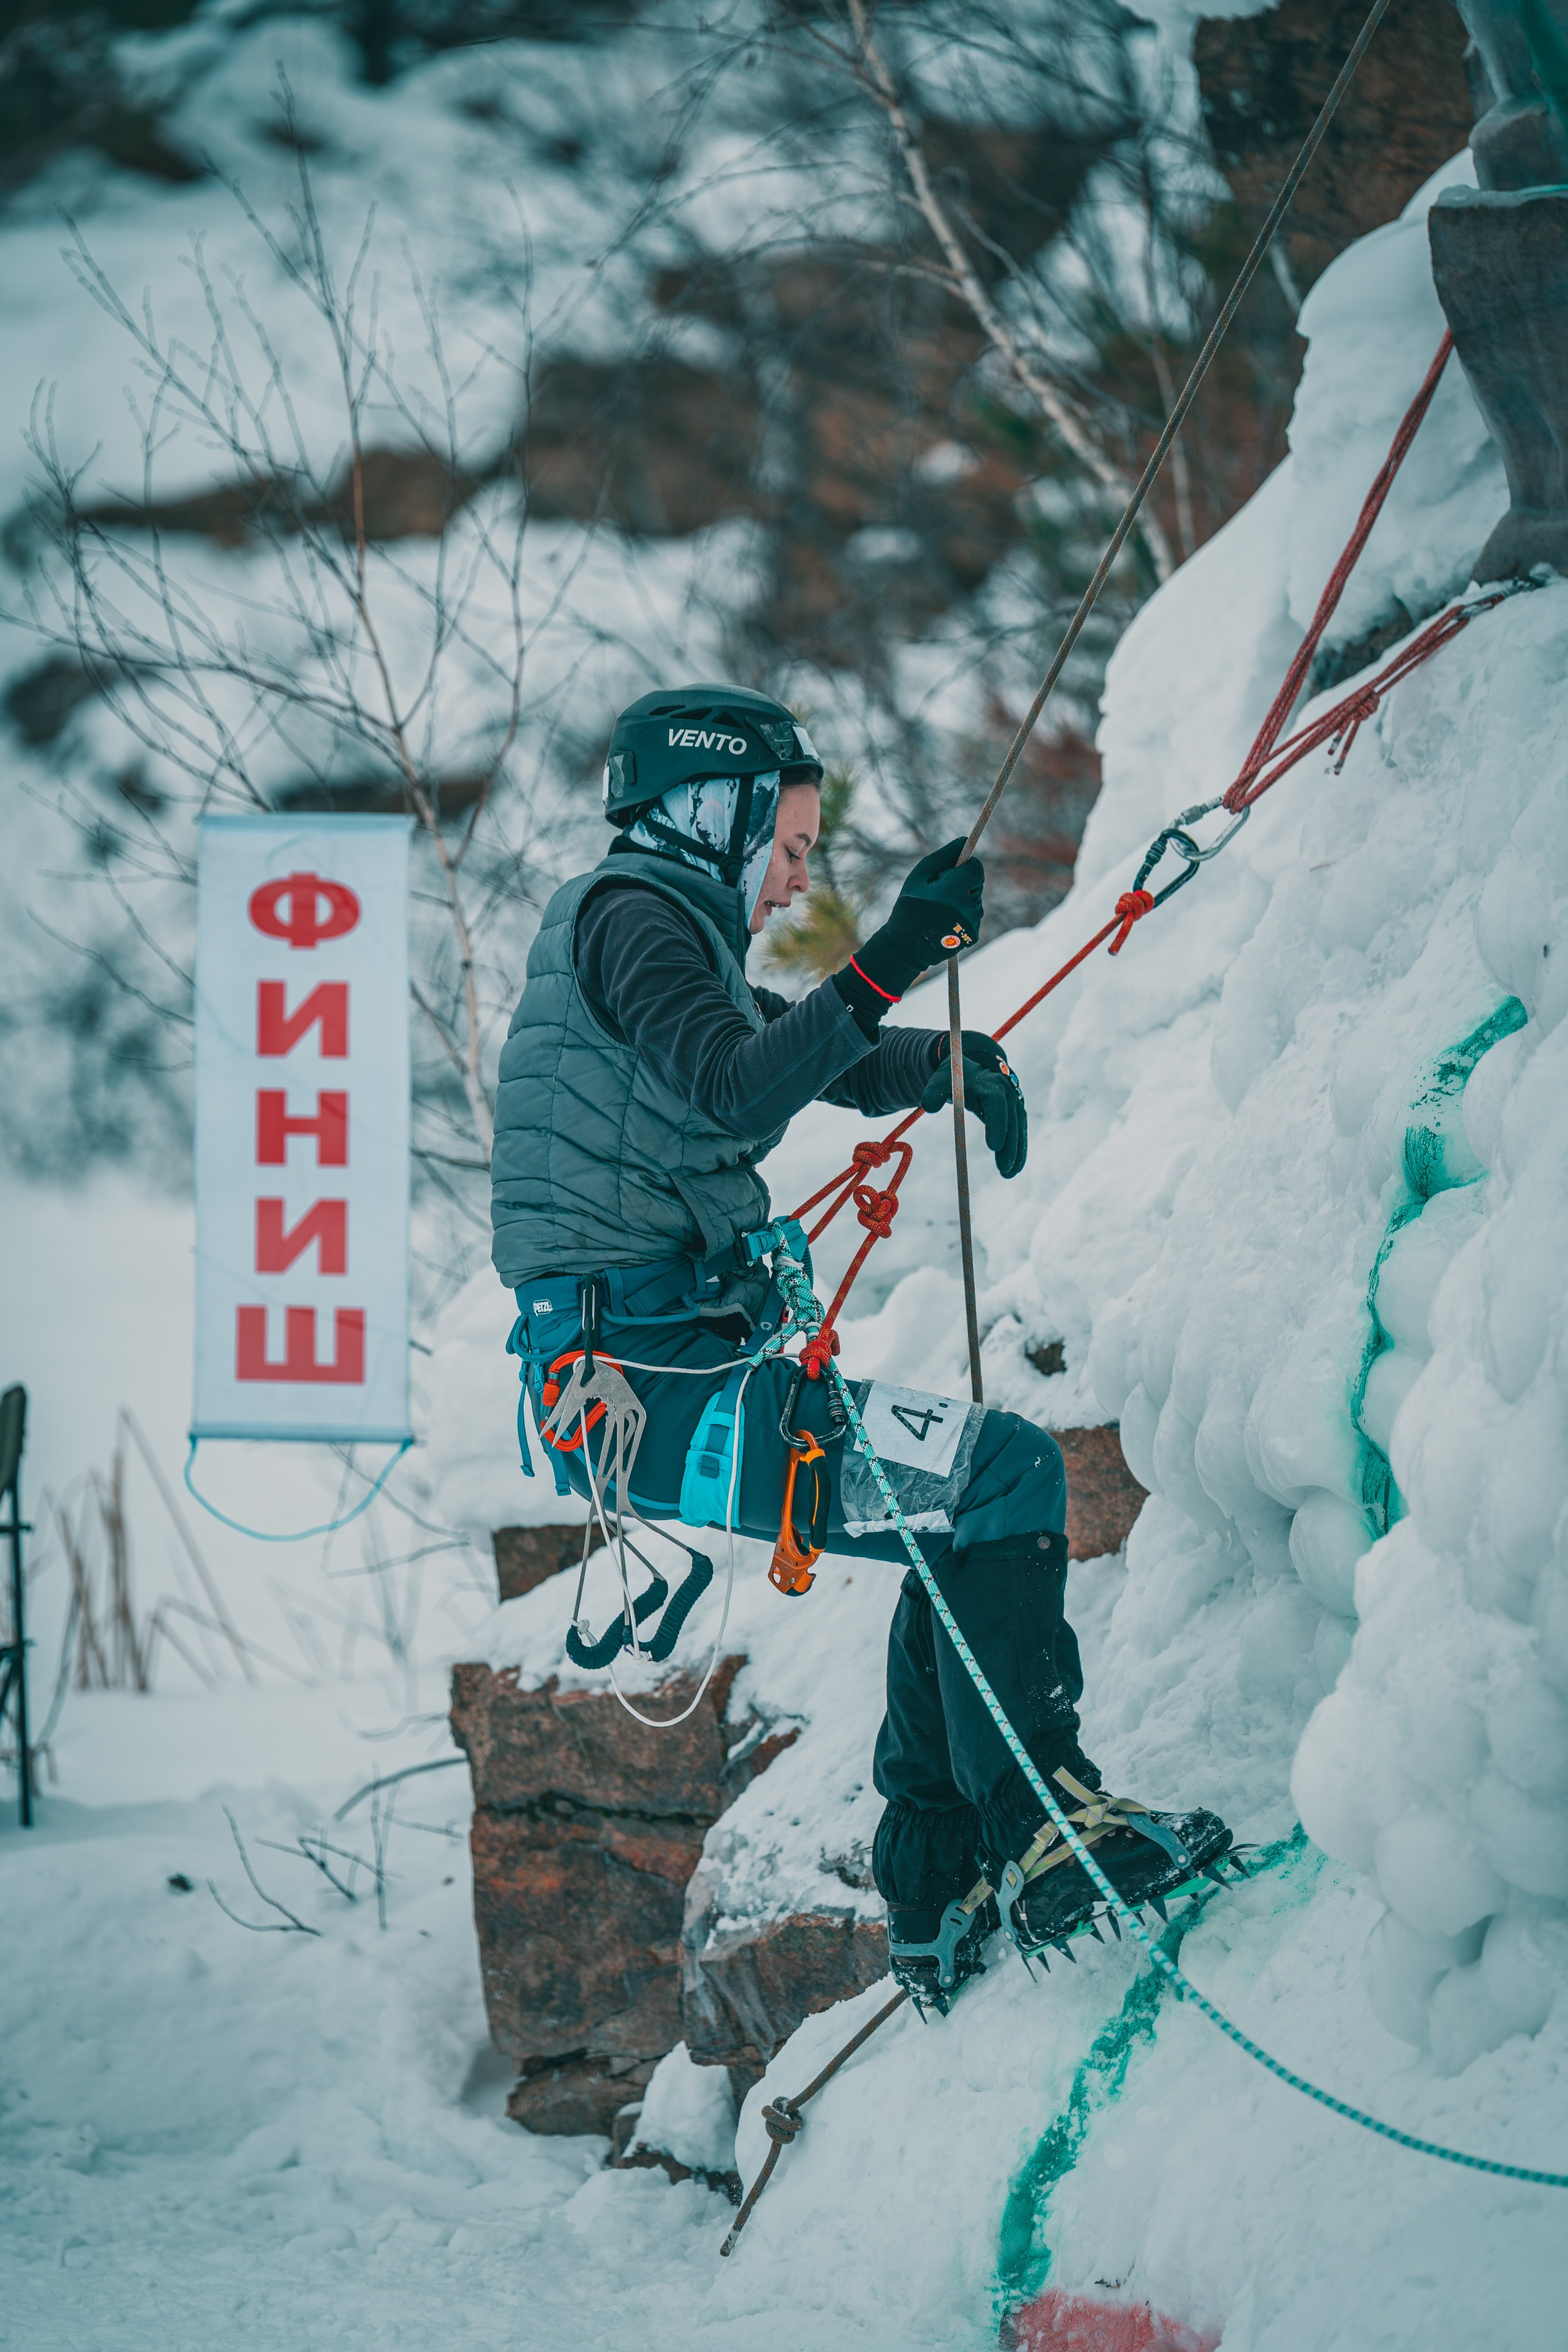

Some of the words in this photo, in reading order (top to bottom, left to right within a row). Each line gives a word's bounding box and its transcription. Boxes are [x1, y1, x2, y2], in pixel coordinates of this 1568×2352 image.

[668, 728, 747, 755] VENTO
[235, 871, 366, 1385] ФИНИШ
[533, 1301, 554, 1317] PETZL
